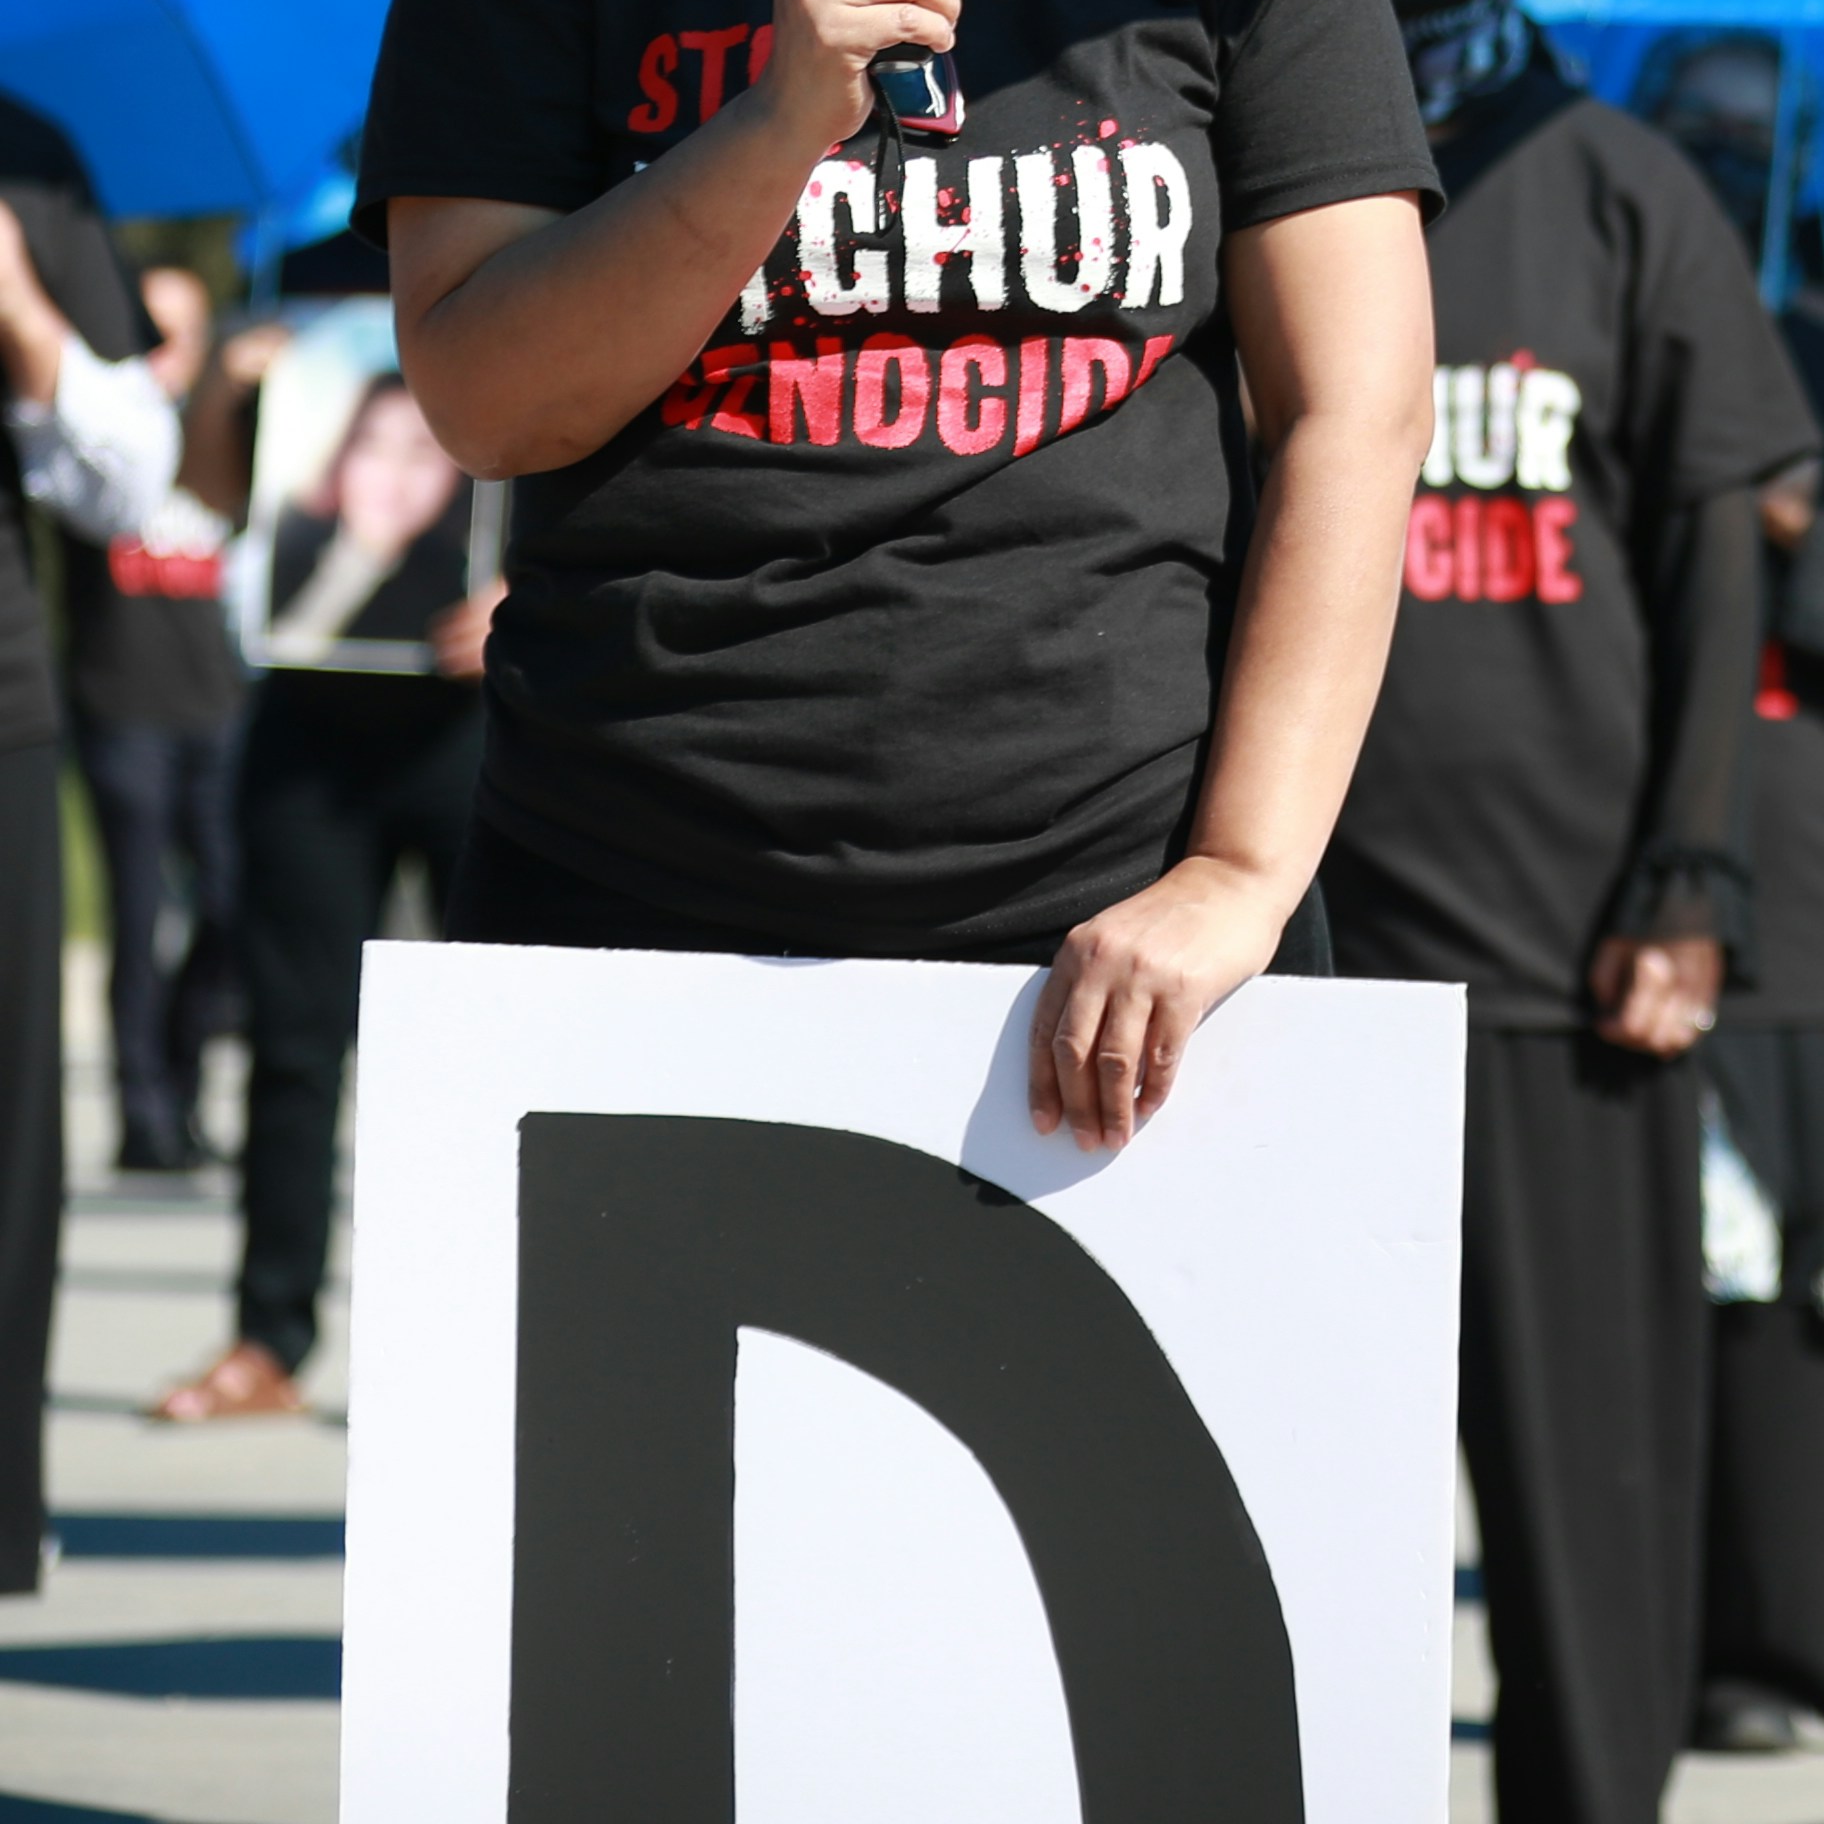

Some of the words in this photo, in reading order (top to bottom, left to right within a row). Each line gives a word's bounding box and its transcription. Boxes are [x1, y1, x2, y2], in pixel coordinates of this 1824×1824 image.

[627, 22, 775, 133] ST
[661, 332, 1175, 457] GENOCID
[506, 1109, 1306, 1824] D
